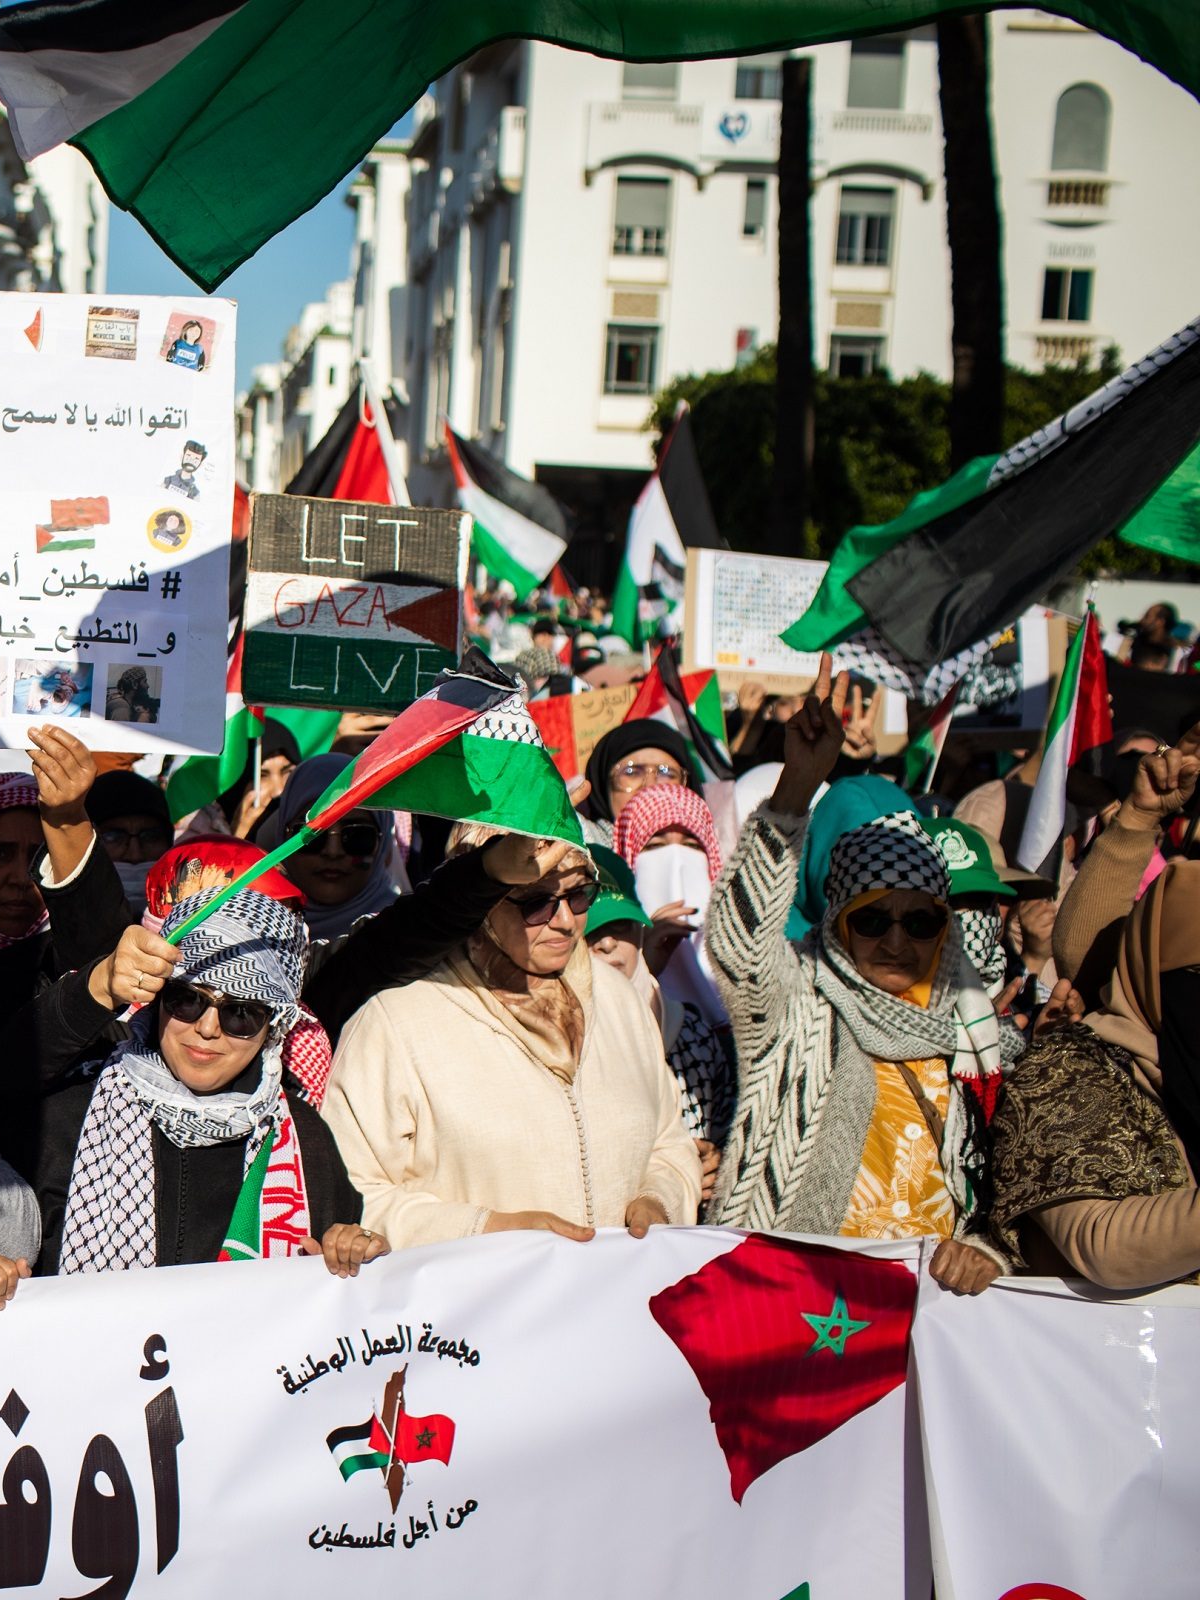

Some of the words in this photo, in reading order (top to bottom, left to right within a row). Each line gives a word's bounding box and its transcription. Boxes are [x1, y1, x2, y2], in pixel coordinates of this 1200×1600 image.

[1, 403, 58, 432] سمح
[64, 402, 78, 425] لا
[84, 404, 98, 432] يا
[104, 402, 132, 426] الله
[139, 405, 188, 437] اتقوا
[301, 504, 419, 572] LET
[274, 578, 392, 633] GAZA
[289, 636, 441, 700] LIVE
[361, 1324, 413, 1366] العمل
[417, 1322, 481, 1368] مجموعة
[275, 1336, 356, 1395] الوطنية
[402, 1500, 439, 1549] أجل
[445, 1499, 479, 1529] من
[308, 1521, 396, 1552] فلسطين
